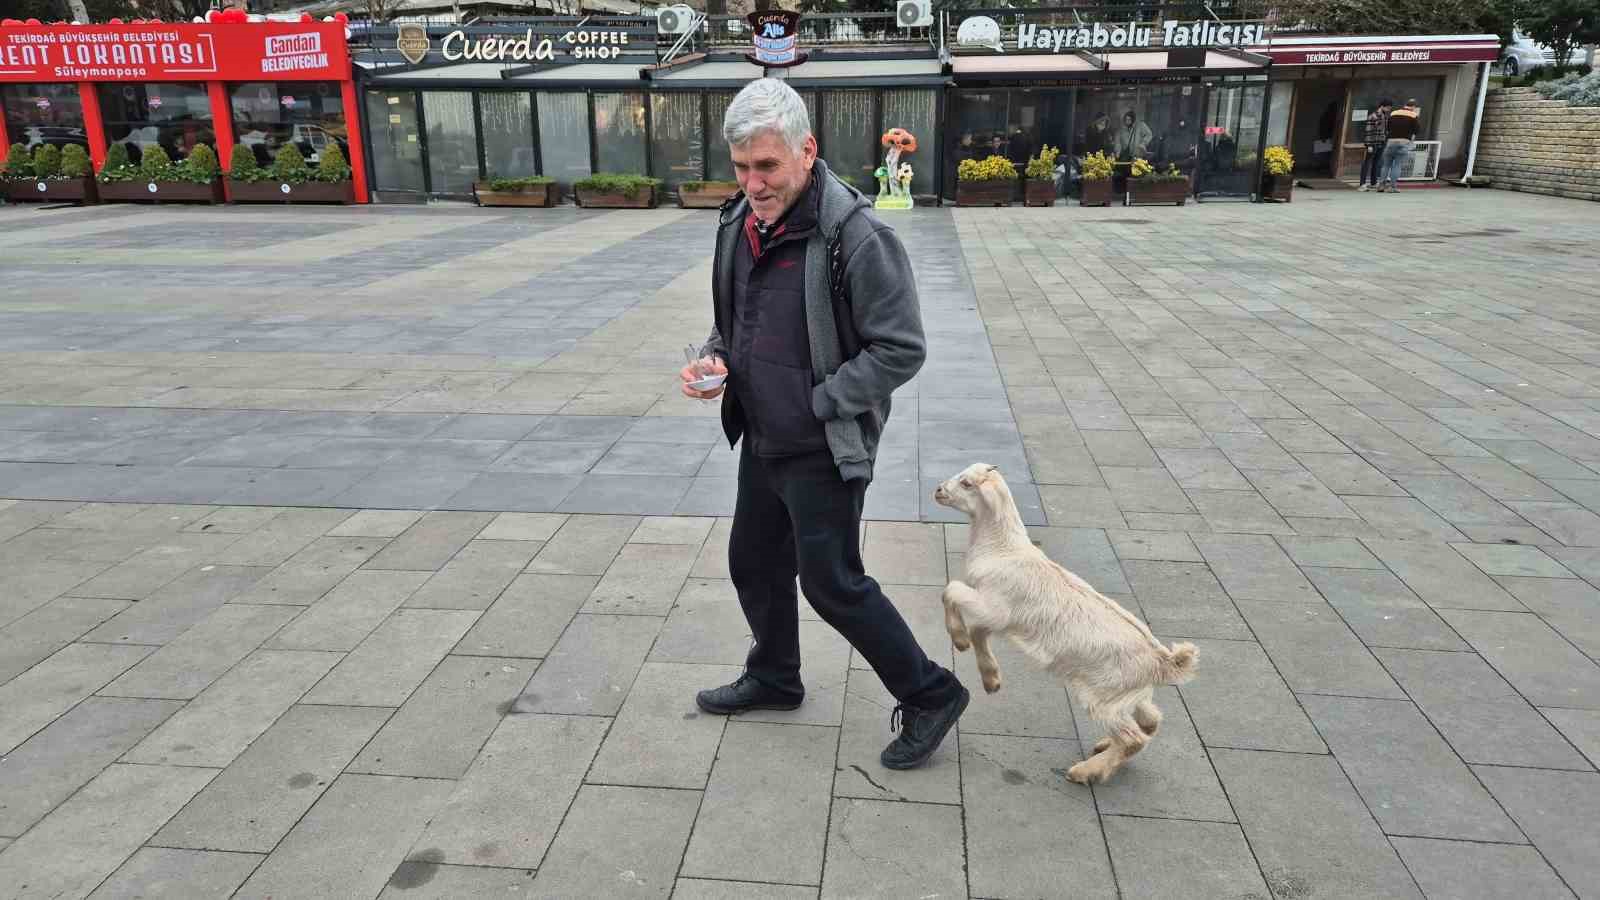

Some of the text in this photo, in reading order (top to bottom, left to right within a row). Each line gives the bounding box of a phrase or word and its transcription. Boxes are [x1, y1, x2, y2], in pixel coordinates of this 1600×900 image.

[8, 30, 179, 43] TEKİRDAĞ BÜYÜKŞEHİR BELEDİYESİ
[271, 35, 316, 54] Candan
[441, 28, 628, 61] Cuerda COFFEE
[1016, 20, 1265, 53] Hayrabolu Tatlıcısı
[62, 43, 204, 65] LOKANTASI
[575, 45, 621, 59] SHOP
[1305, 50, 1430, 63] TEKİRDAĞ BÜYÜKŞEHİR BELEDİYESİ
[54, 66, 147, 78] Süleymanpaşa
